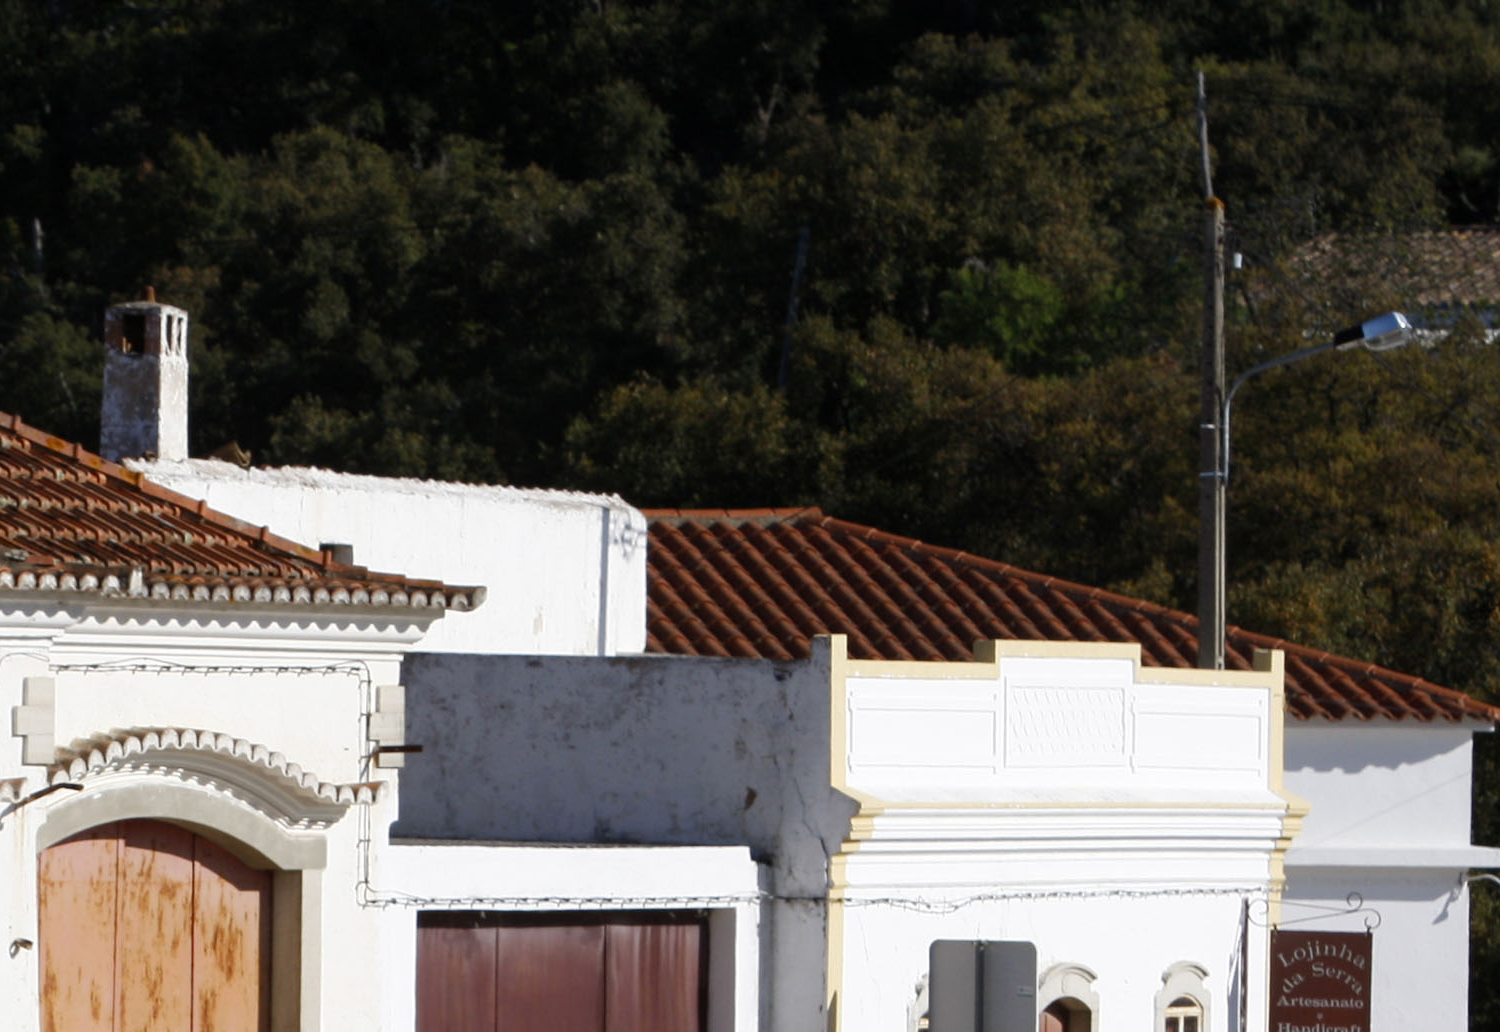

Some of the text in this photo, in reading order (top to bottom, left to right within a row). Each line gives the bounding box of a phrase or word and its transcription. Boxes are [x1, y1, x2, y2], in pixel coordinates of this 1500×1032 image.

[1277, 940, 1366, 970] Lojinha
[1282, 961, 1364, 996] da Serra
[1276, 995, 1364, 1009] Artesanato
